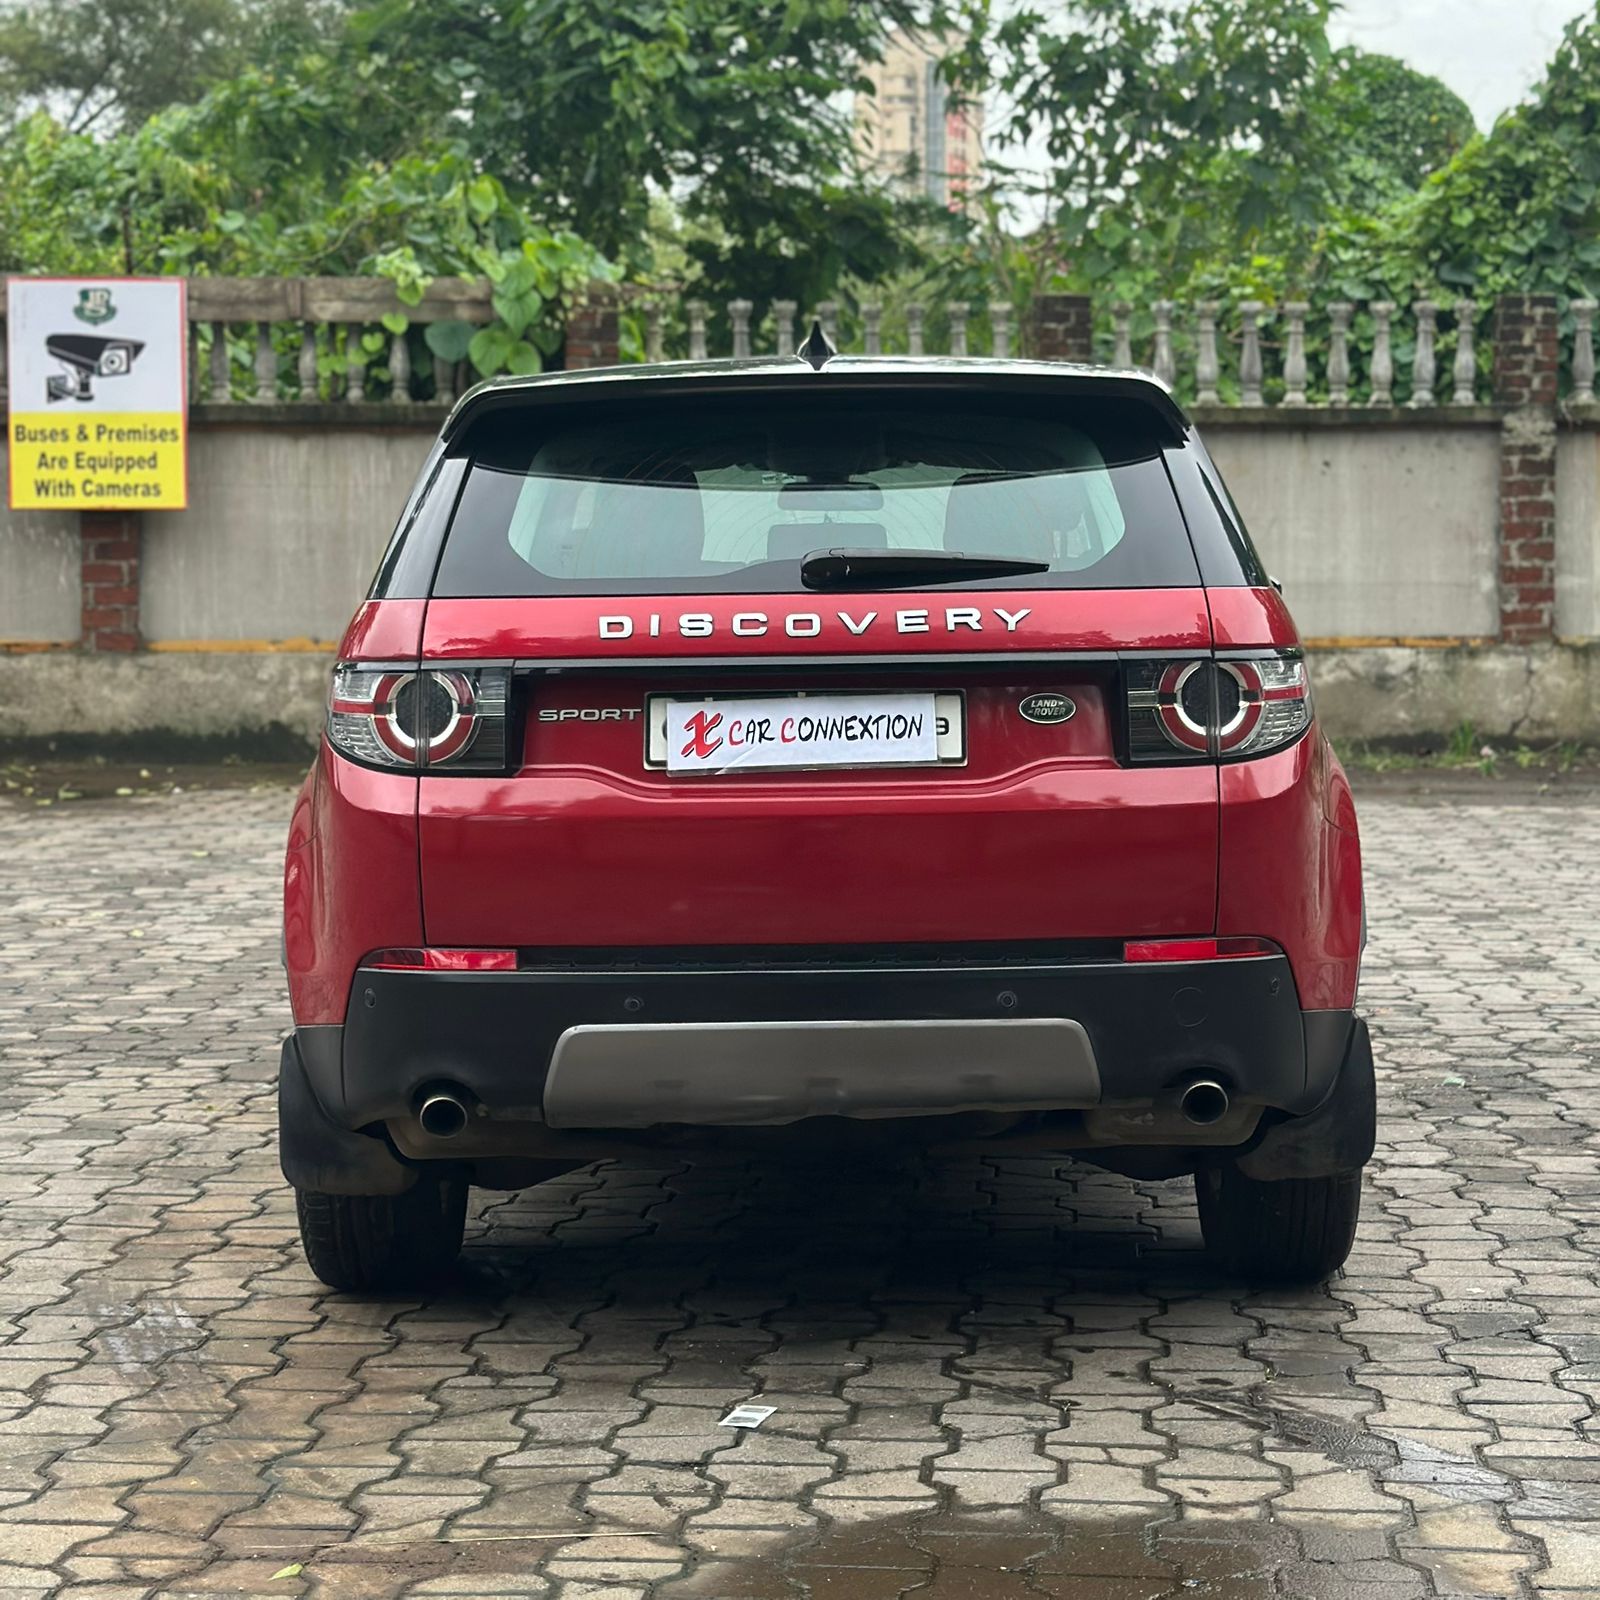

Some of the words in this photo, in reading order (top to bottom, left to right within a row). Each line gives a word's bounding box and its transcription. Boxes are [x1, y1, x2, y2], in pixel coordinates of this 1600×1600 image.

[15, 424, 69, 443] Buses
[76, 424, 88, 442] &
[96, 424, 180, 443] Premises
[37, 452, 69, 471] Are
[75, 452, 158, 473] Equipped
[34, 478, 76, 498] With
[81, 478, 161, 498] Cameras
[599, 608, 1032, 639] DISCOVERY
[1031, 700, 1057, 708] LAND
[1033, 707, 1066, 717] ROVER
[538, 708, 642, 721] SPORT
[729, 718, 775, 746] CAR
[780, 713, 923, 743] CONNEXTION
